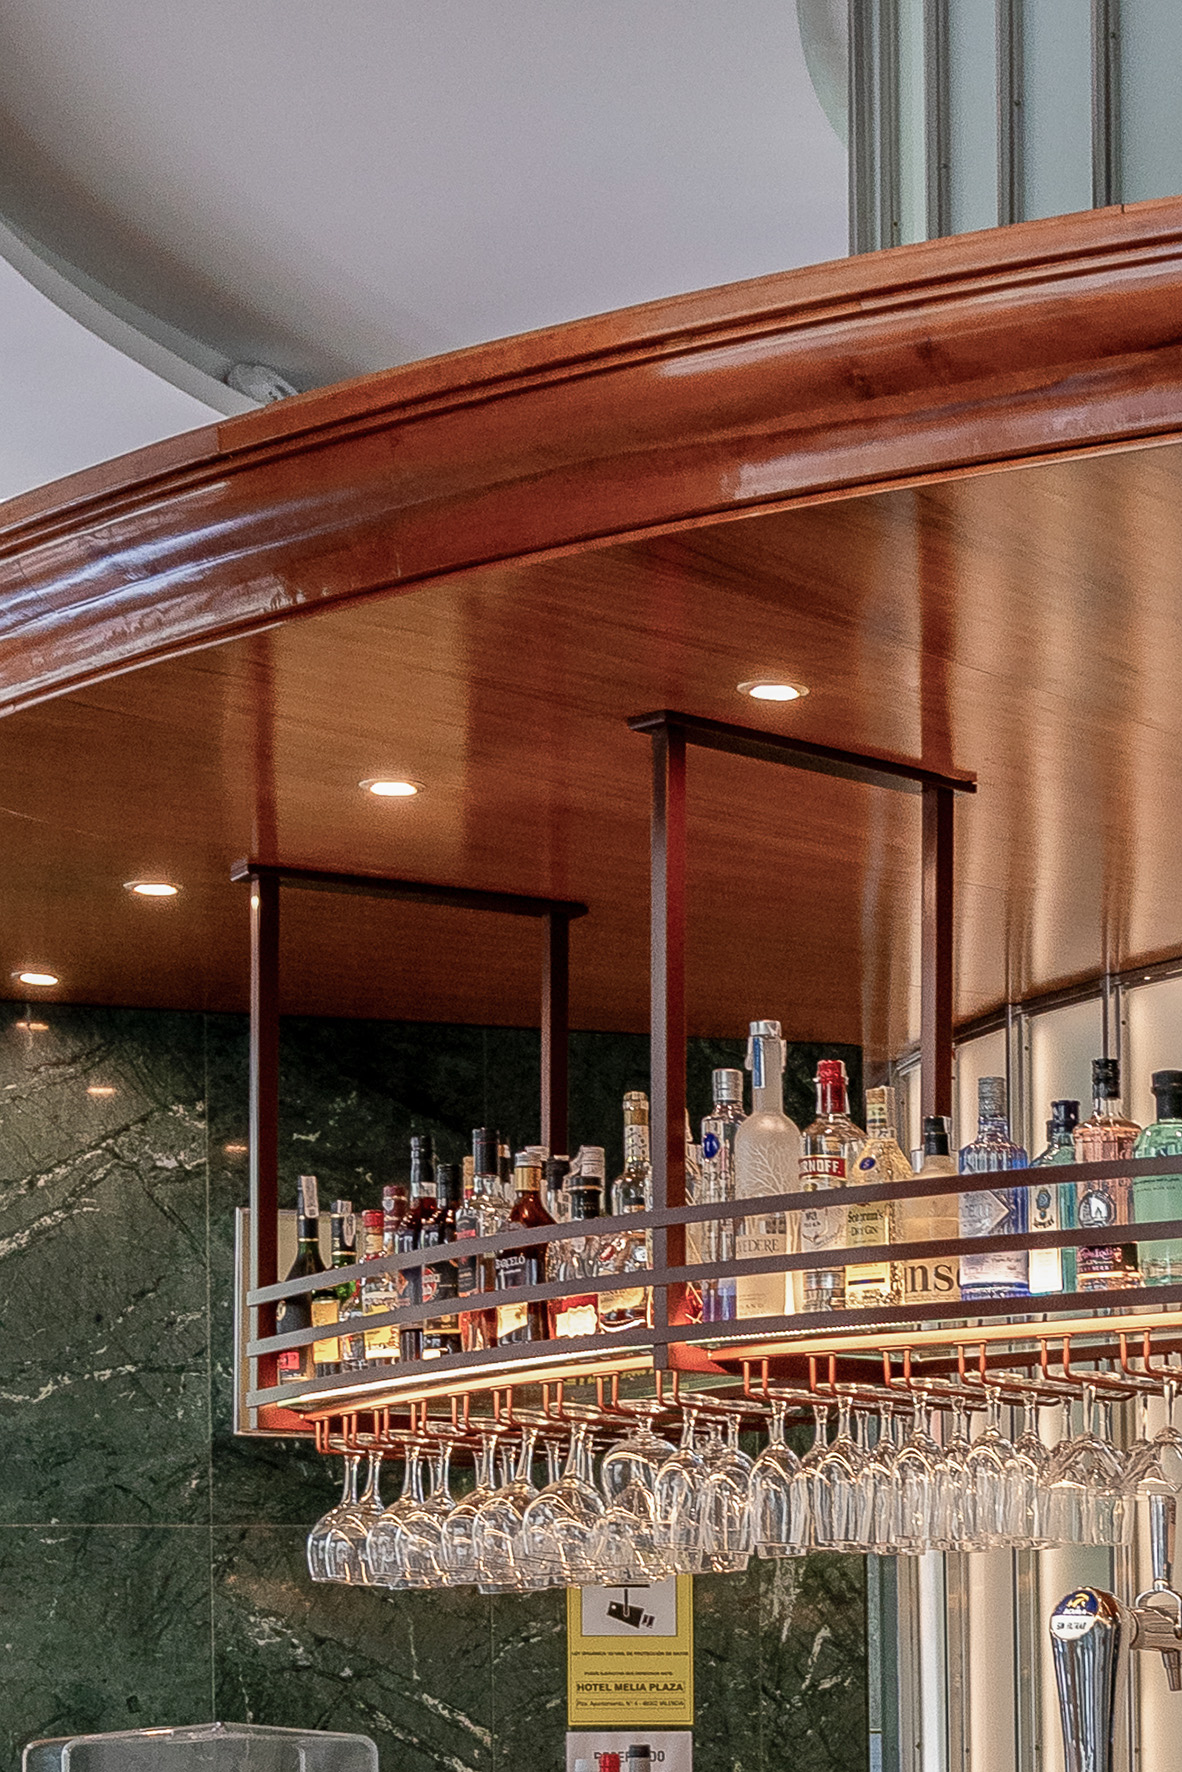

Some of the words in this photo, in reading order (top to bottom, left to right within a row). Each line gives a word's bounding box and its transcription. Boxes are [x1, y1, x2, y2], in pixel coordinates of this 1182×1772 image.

[577, 1683, 612, 1691] HOTEL
[614, 1683, 647, 1691] MELIA
[649, 1683, 684, 1691] PLAZA
